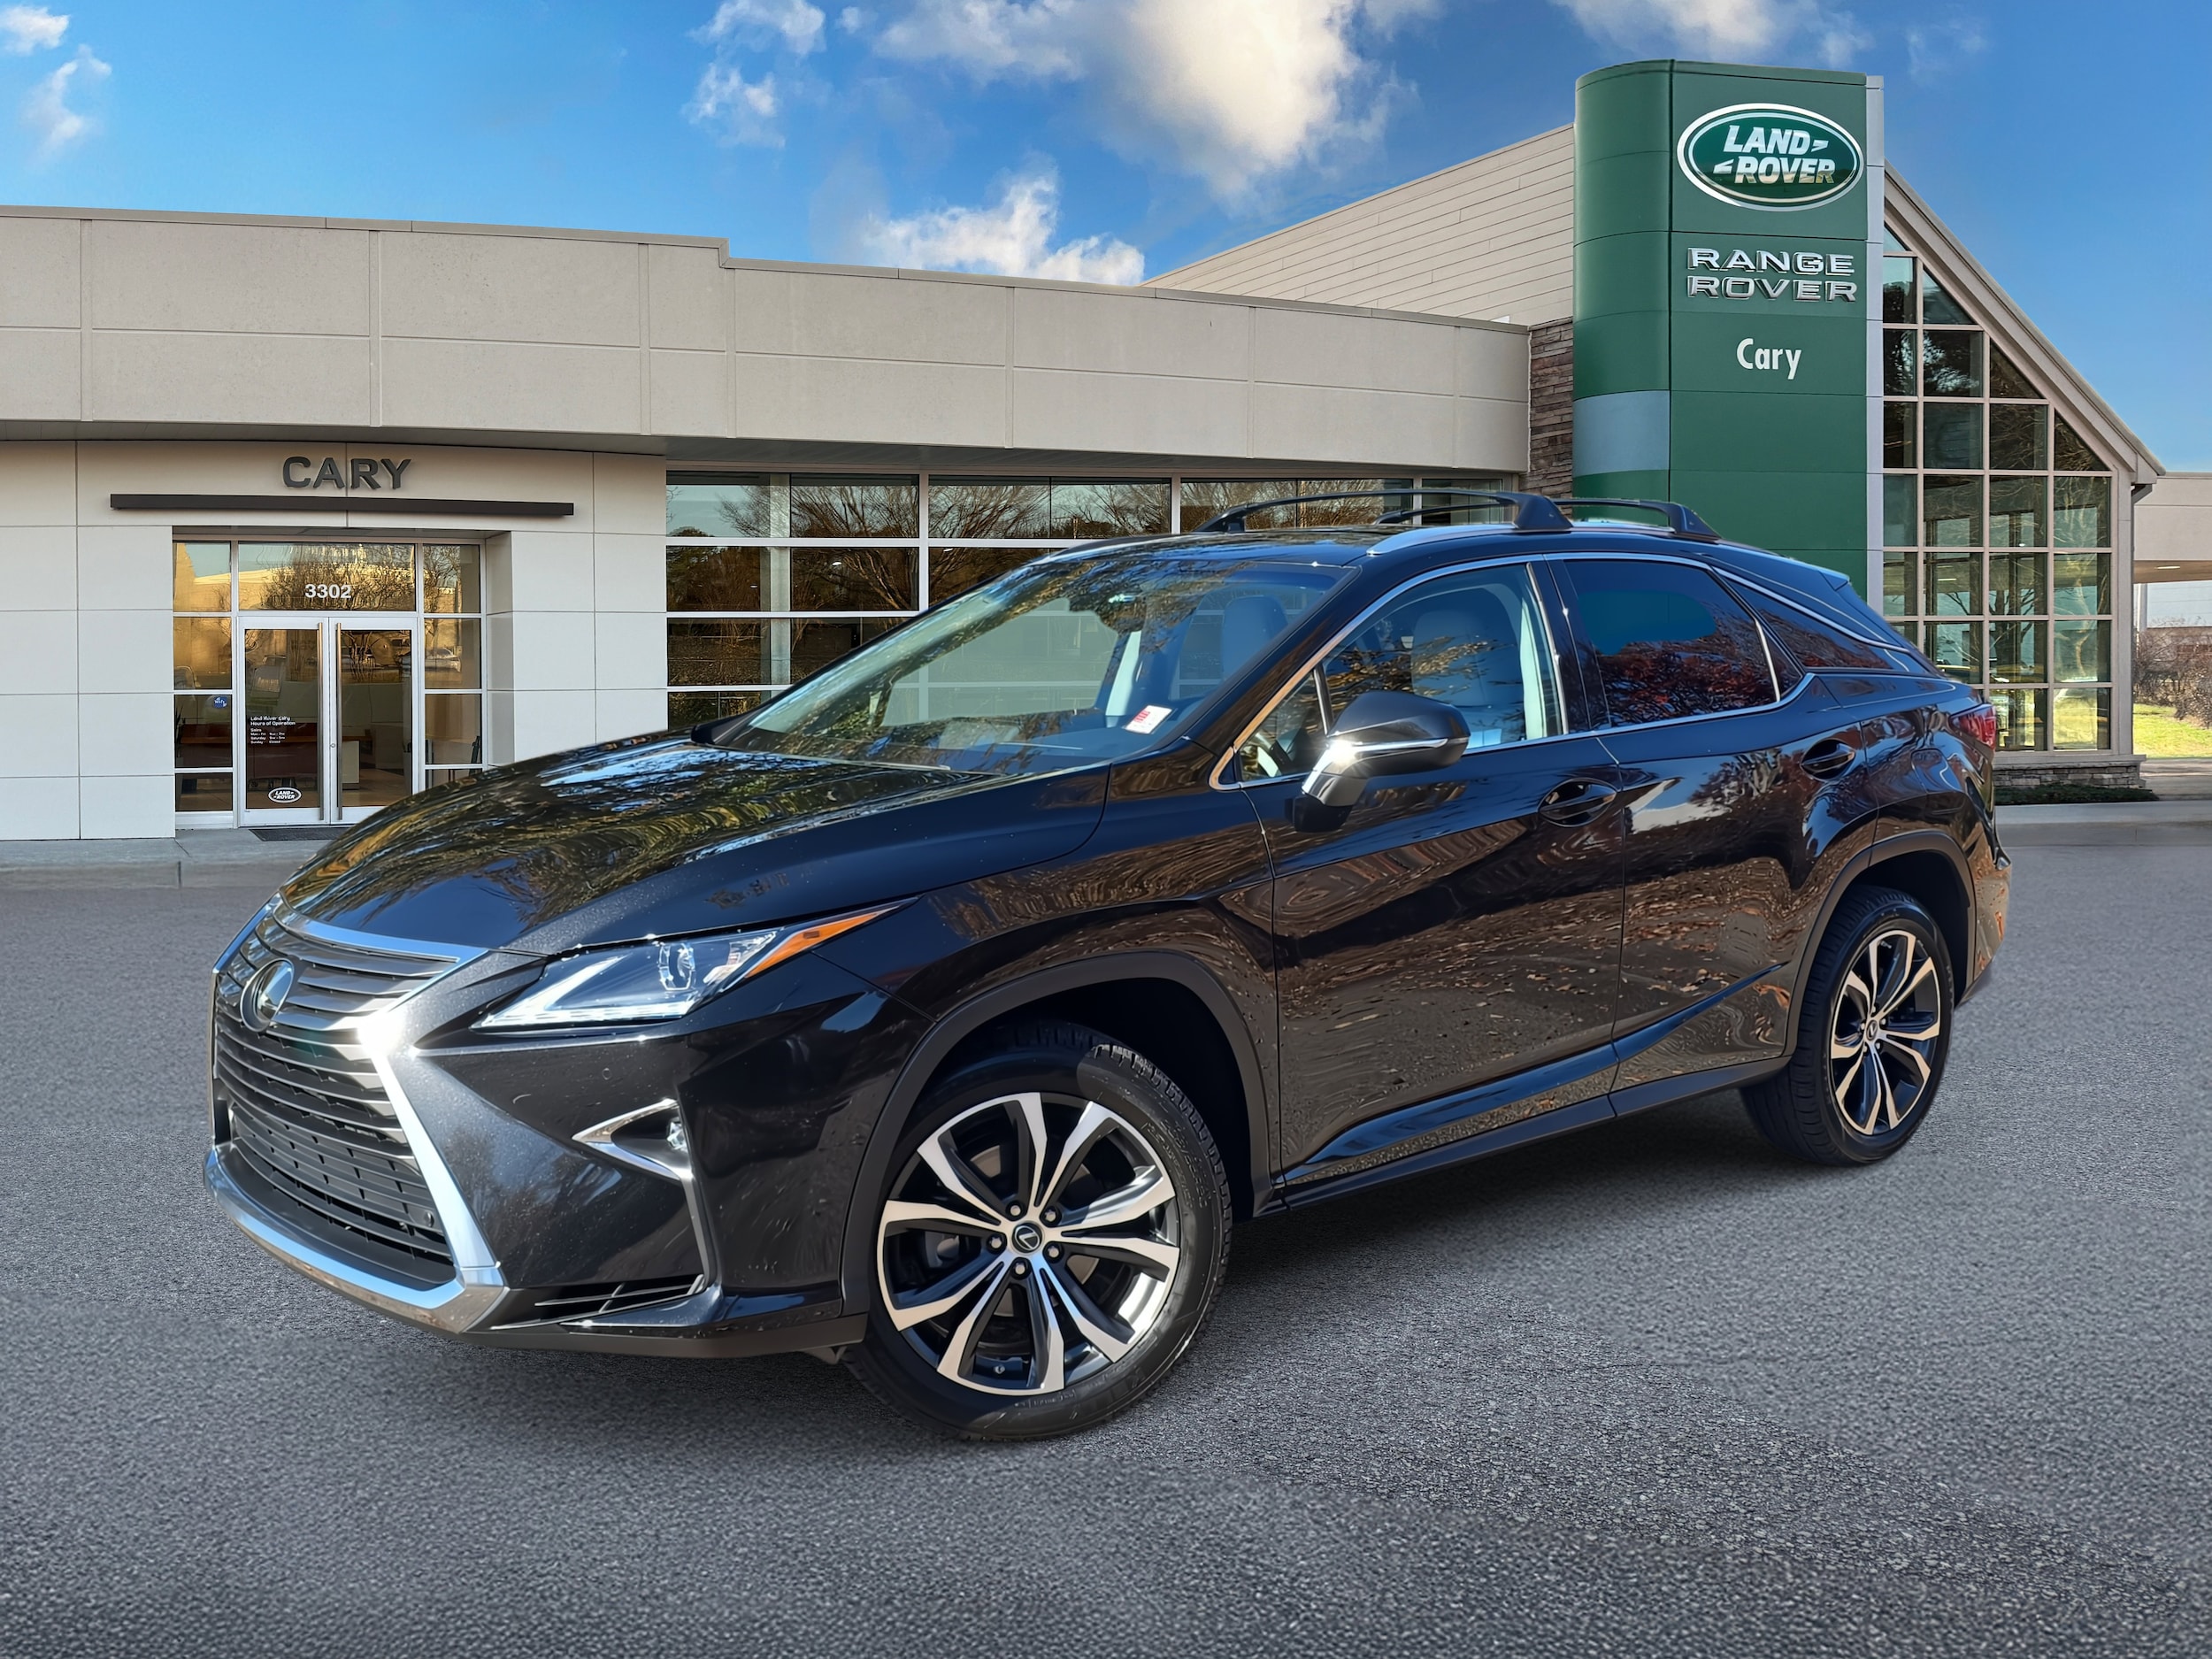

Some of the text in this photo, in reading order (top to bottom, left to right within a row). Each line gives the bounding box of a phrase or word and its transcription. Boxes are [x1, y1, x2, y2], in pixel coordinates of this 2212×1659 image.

[1723, 125, 1811, 156] LAND
[1733, 156, 1836, 184] ROVER
[1686, 247, 1855, 276] RANGE
[1686, 275, 1858, 303] ROVER
[1736, 338, 1802, 380] Cary
[282, 456, 412, 489] CARY
[304, 584, 353, 599] 3302
